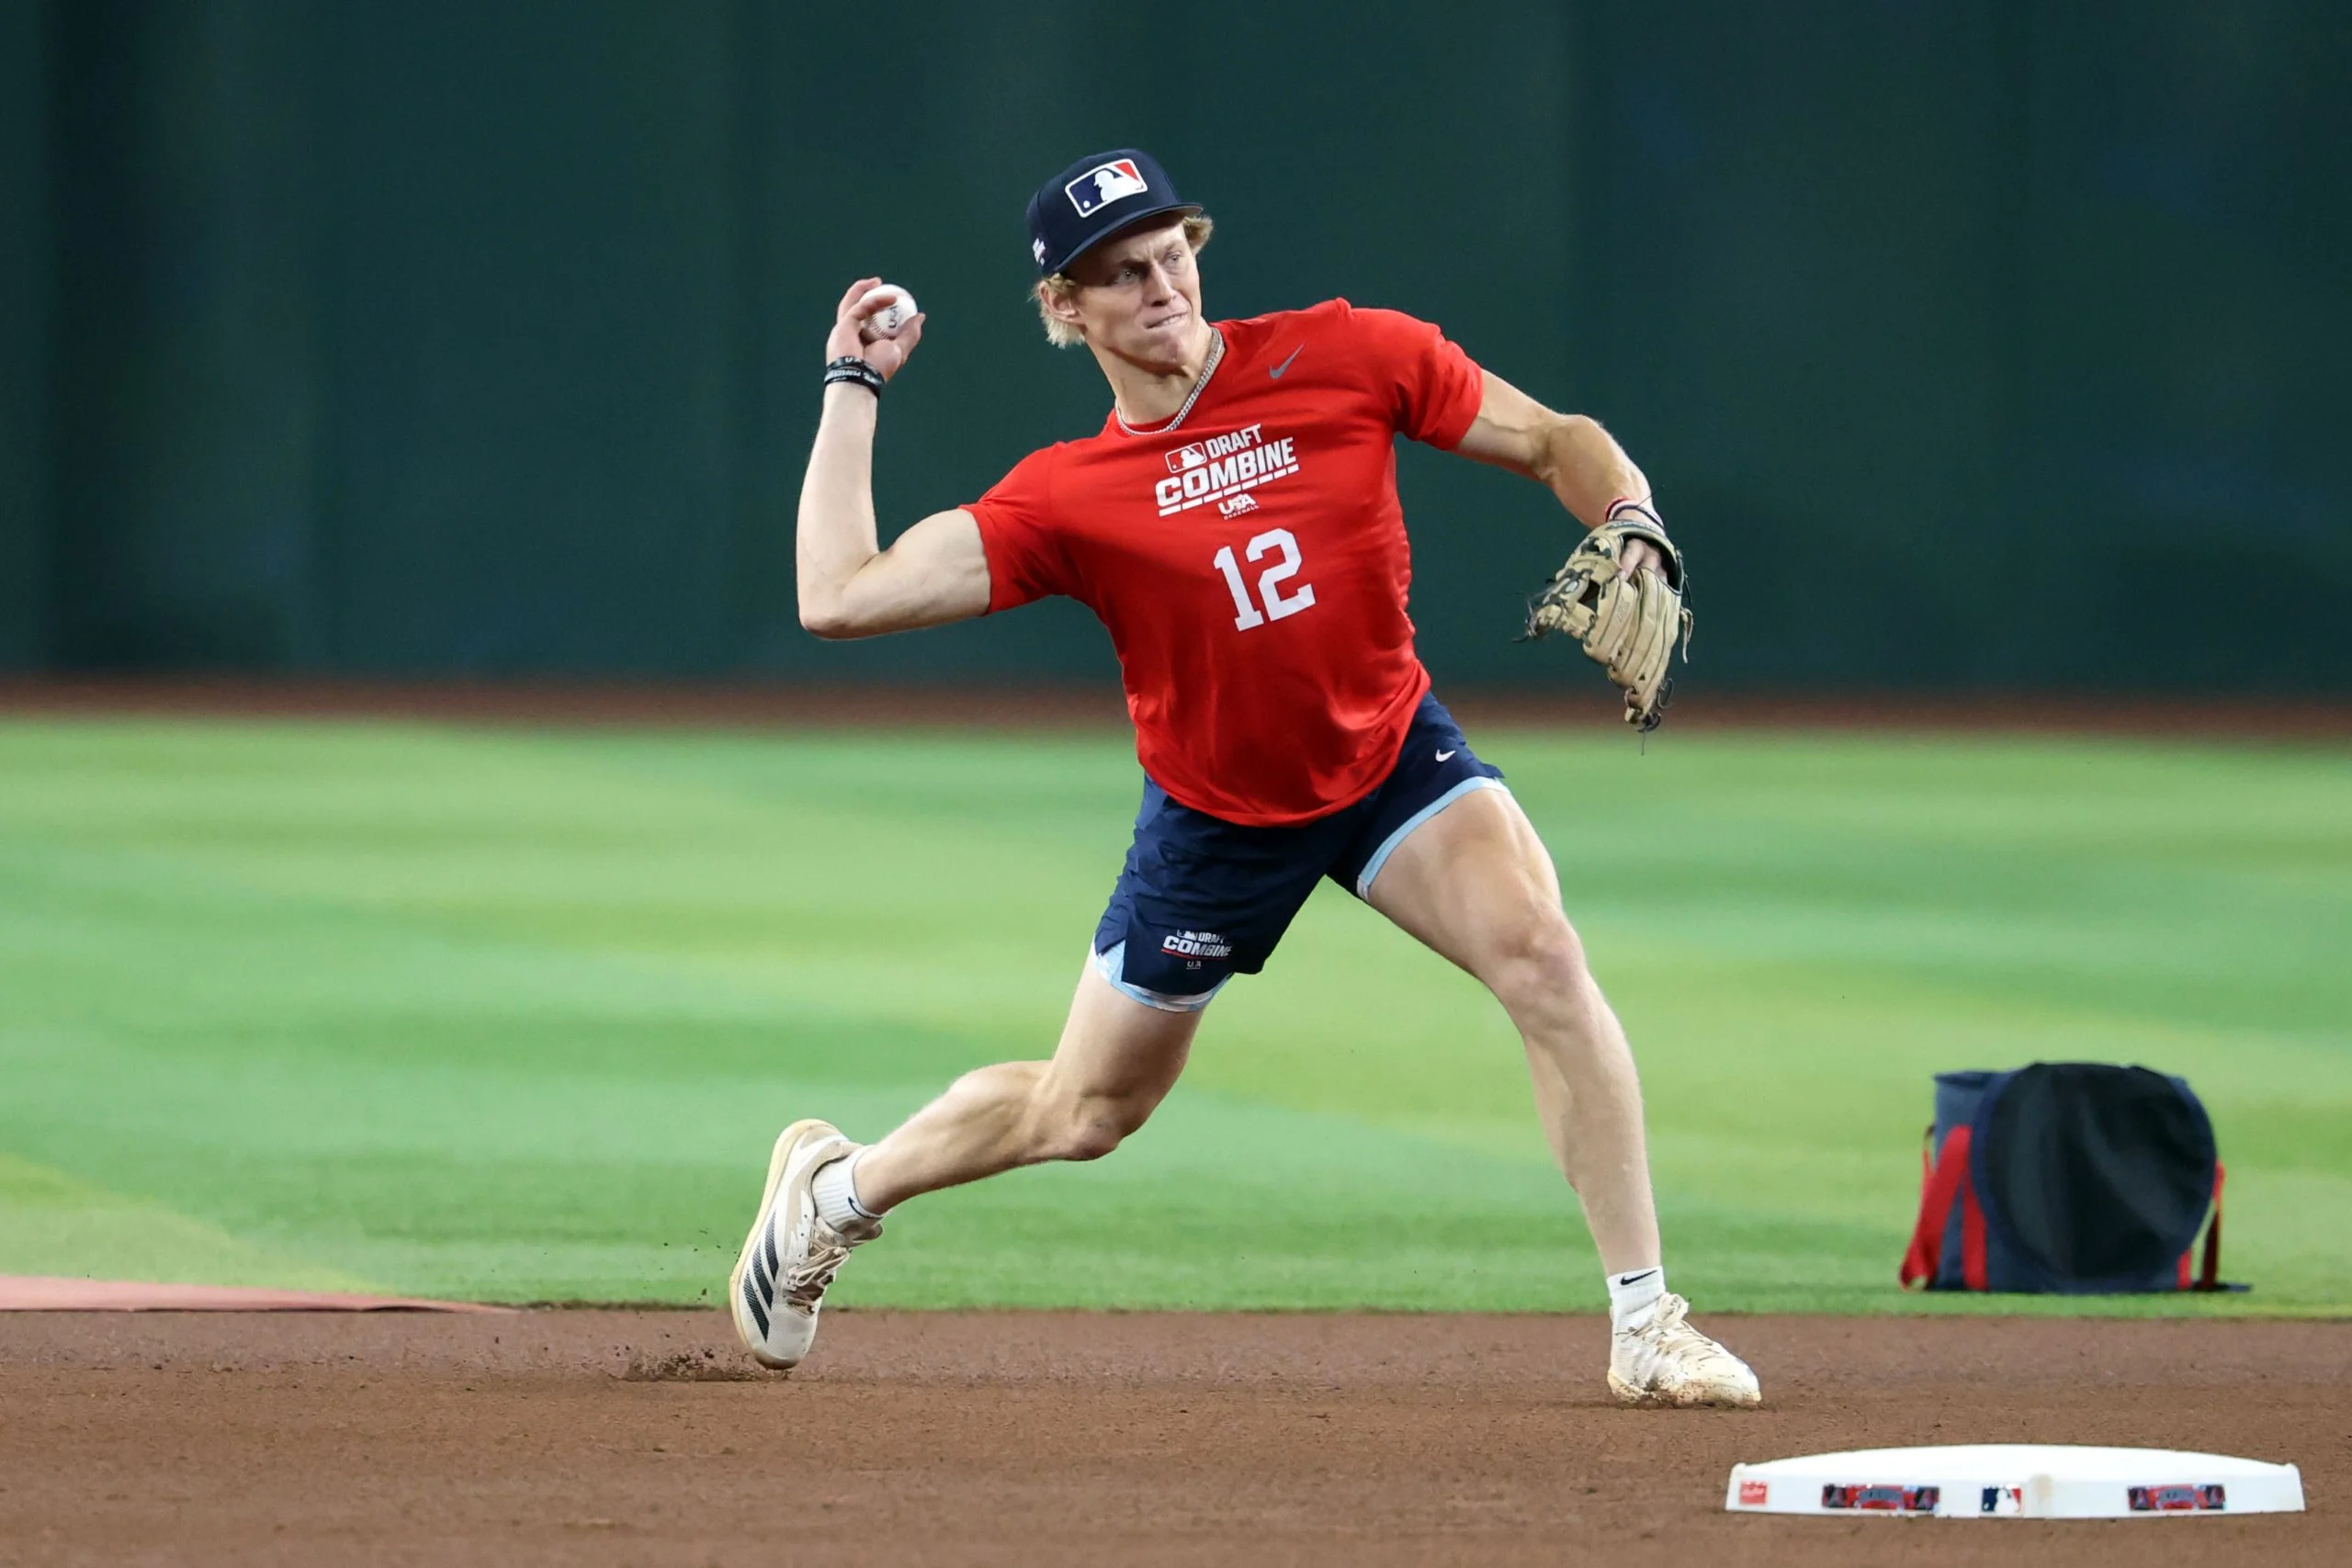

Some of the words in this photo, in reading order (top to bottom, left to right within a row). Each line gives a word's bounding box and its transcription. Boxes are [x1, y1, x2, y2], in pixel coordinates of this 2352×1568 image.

[1155, 437, 1296, 507] COMBINE
[1206, 423, 1261, 458] DRAFT
[1214, 528, 1316, 632] 12
